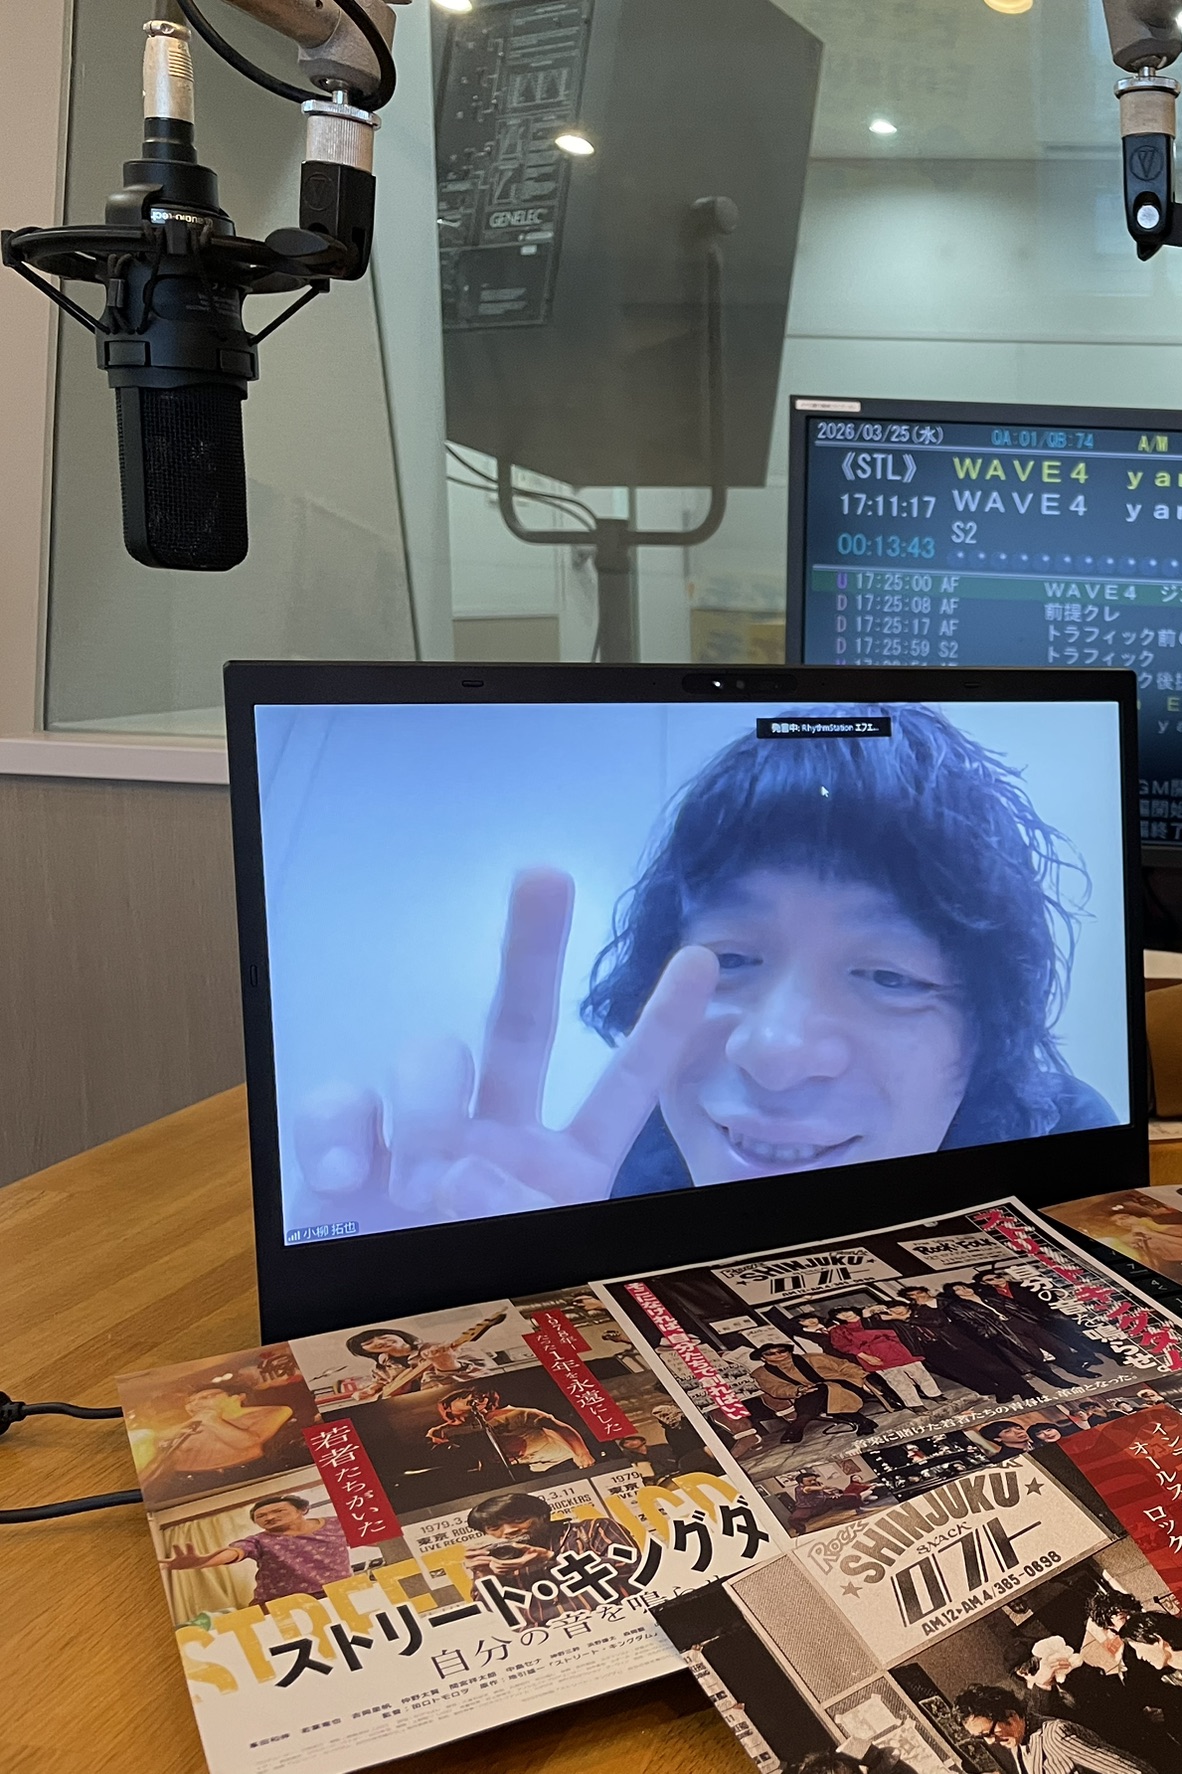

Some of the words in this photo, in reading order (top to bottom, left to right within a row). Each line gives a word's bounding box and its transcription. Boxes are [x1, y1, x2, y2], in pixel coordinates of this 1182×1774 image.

[817, 422, 944, 445] 2026/03/25(水)
[953, 456, 1088, 484] WAVE4
[840, 492, 936, 518] 17:11:17
[952, 488, 1087, 516] WAVE4
[837, 533, 936, 559] 00:13:43
[951, 521, 977, 544] S2
[856, 573, 932, 593] 17:25:00
[940, 576, 960, 594] AF
[1044, 582, 1137, 601] WAVE4
[855, 594, 931, 614] 17:25:08
[939, 597, 960, 615] AF
[855, 615, 931, 635] 17:25:17
[939, 618, 960, 637] AF
[938, 640, 959, 659] S2
[1047, 646, 1155, 668] トラフィック
[310, 1425, 387, 1538] 若者たちがいた
[839, 1470, 1022, 1585] SHINJUKU
[915, 1520, 973, 1556] SNACK
[889, 1516, 1042, 1628] ロフト
[268, 1494, 771, 1688] ストリート・キングダ
